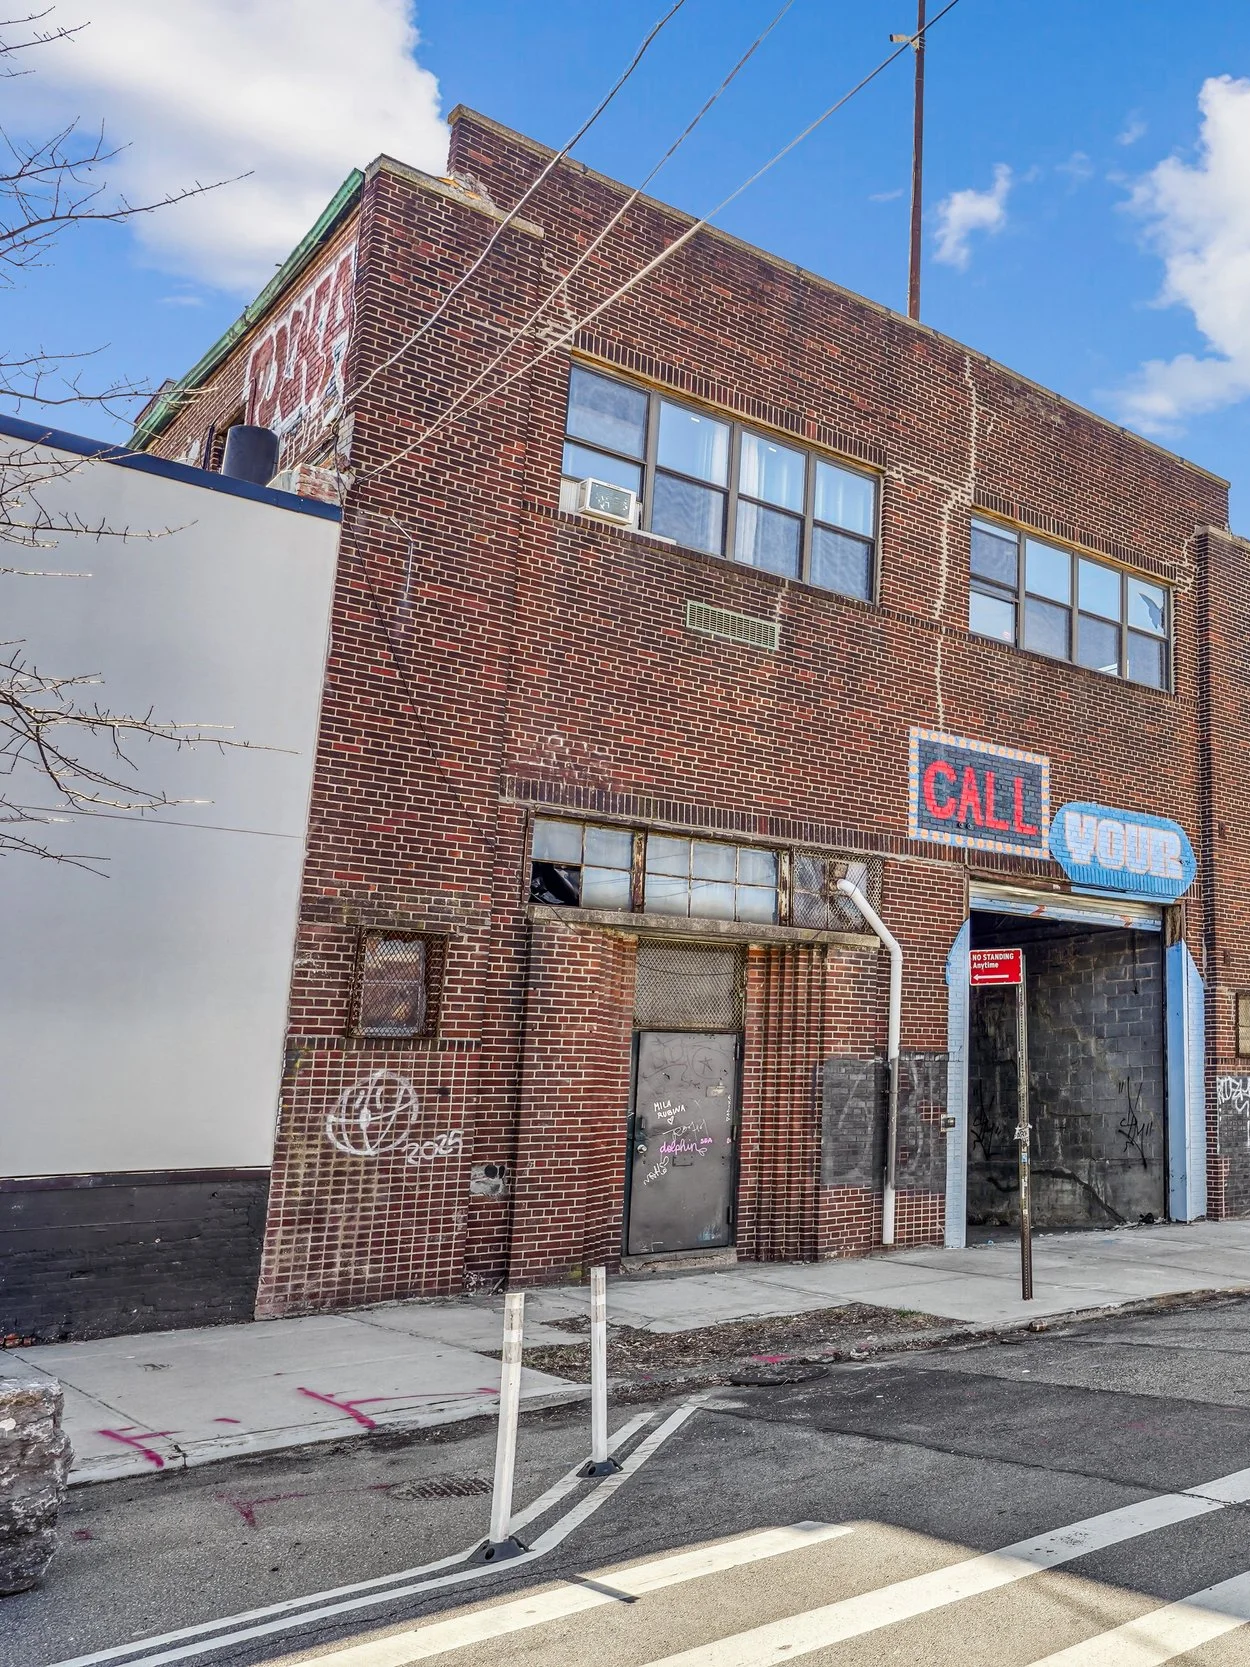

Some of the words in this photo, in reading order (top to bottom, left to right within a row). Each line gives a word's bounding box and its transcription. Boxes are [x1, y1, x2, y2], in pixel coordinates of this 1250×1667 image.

[922, 759, 1038, 836] CALL
[1064, 810, 1183, 880] YOUR
[983, 953, 1014, 961] STANDING
[973, 962, 999, 970] Anytime
[653, 1100, 671, 1112] MILA
[657, 1104, 686, 1119] RUBINA
[401, 1130, 464, 1165] 2025
[660, 1139, 704, 1156] dolphin
